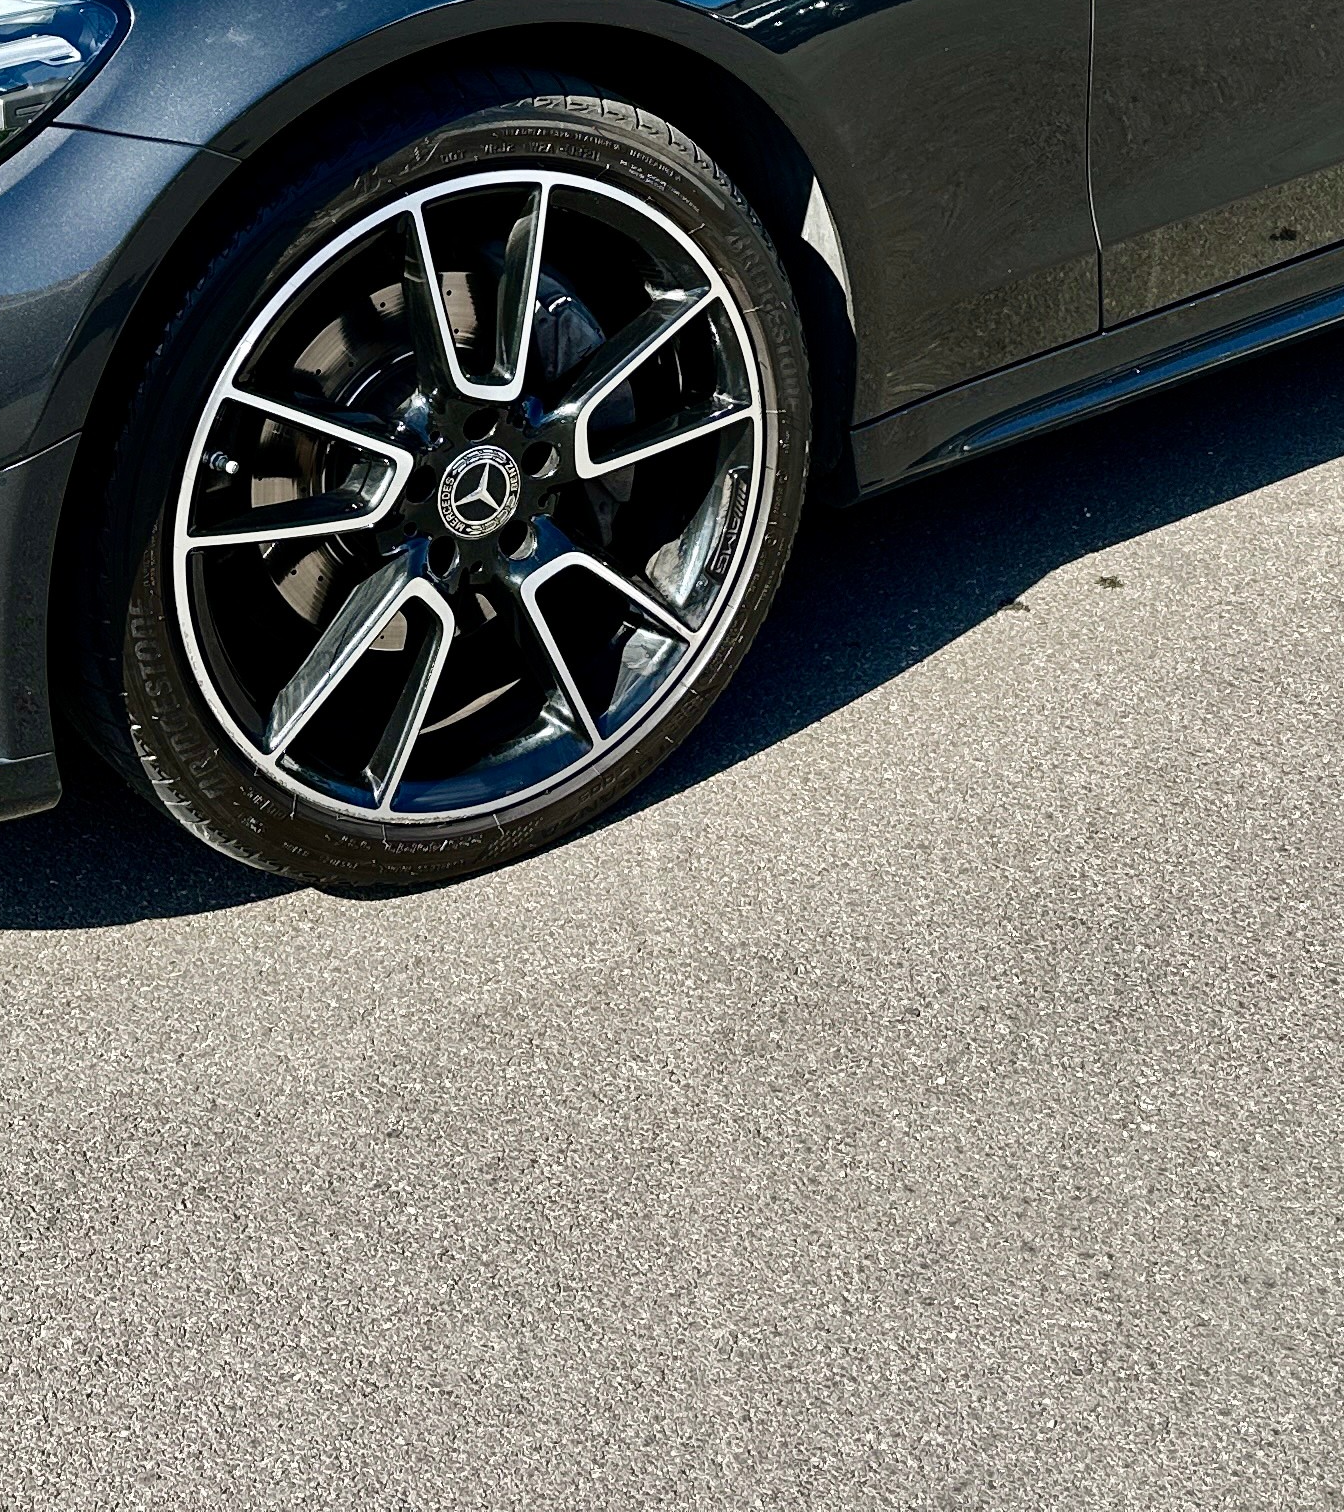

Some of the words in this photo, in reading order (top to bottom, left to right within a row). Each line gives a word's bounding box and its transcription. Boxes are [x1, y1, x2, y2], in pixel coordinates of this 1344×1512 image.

[725, 226, 799, 415] BRIDGESTONE
[441, 476, 466, 532] MERCEDES
[504, 460, 519, 492] BENZ
[129, 599, 225, 799] BRIDGESTONE
